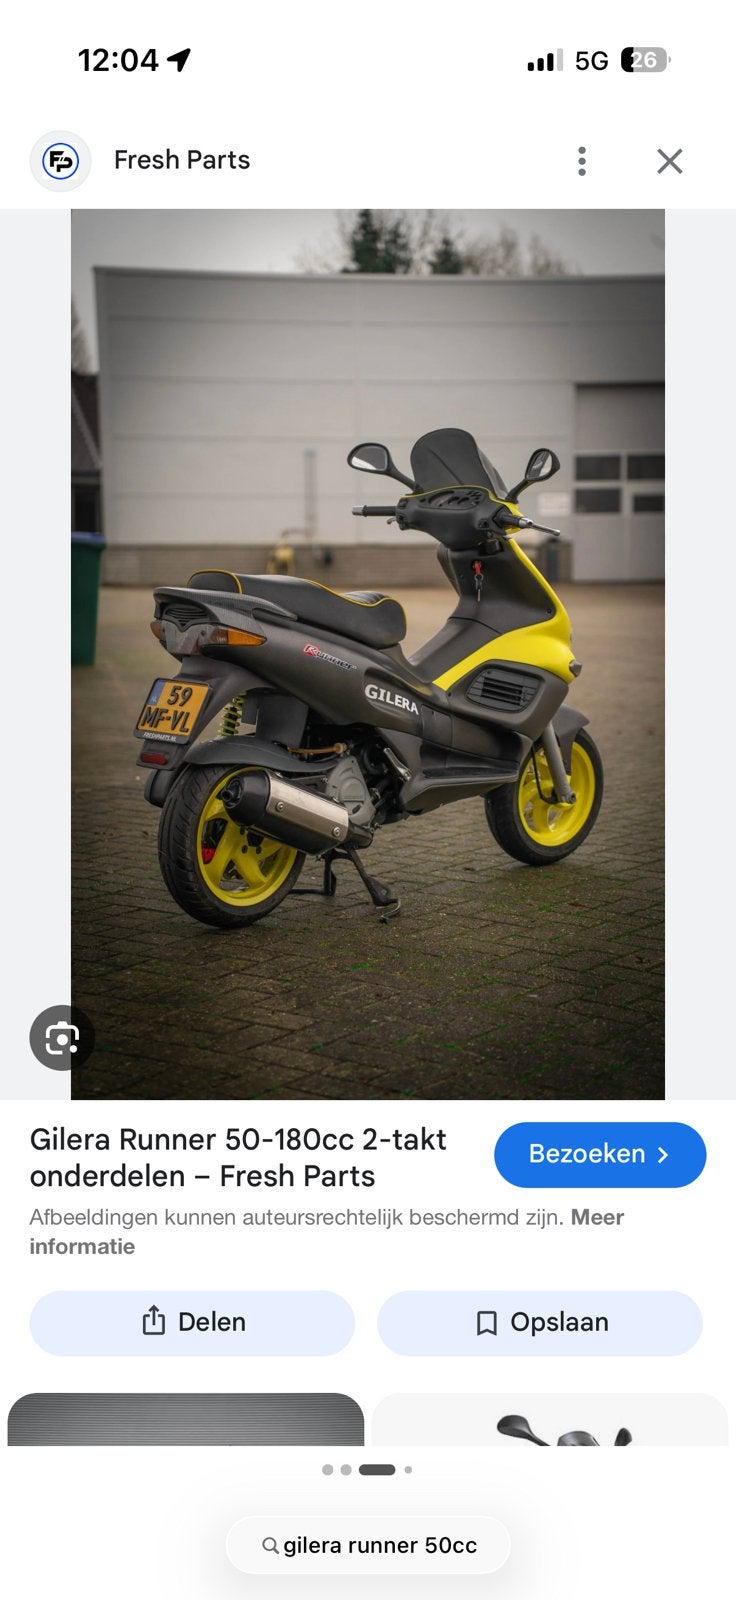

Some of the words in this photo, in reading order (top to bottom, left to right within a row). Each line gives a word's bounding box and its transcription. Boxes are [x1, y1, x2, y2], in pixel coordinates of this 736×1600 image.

[79, 48, 159, 73] 12:04
[576, 51, 609, 72] 5G
[631, 51, 657, 69] 26
[115, 148, 180, 170] Fresh
[188, 150, 251, 170] Parts
[167, 685, 193, 707] 59
[364, 683, 420, 715] GILERA
[140, 706, 191, 733] MF-VL
[30, 1125, 110, 1151] Gilera
[121, 1127, 217, 1151] Runner
[226, 1127, 355, 1152] 50-180cc
[363, 1125, 447, 1151] 2-takt
[530, 1142, 646, 1165] Bezoeken
[30, 1162, 185, 1188] onderdelen
[221, 1162, 295, 1188] Fresh
[305, 1164, 376, 1188] Parts
[29, 1208, 158, 1230] Afbeeldingen
[165, 1208, 236, 1226] kunnen
[243, 1208, 404, 1230] auteursrechtelijk
[410, 1208, 519, 1226] beschermd
[526, 1208, 564, 1230] zijn.
[571, 1208, 625, 1226] Meer
[29, 1237, 136, 1255] informatie
[179, 1311, 246, 1333] Delen
[511, 1311, 609, 1338] Opslaan
[284, 1536, 342, 1559] gilera
[349, 1540, 418, 1555] runner
[425, 1536, 478, 1555] 50cc
